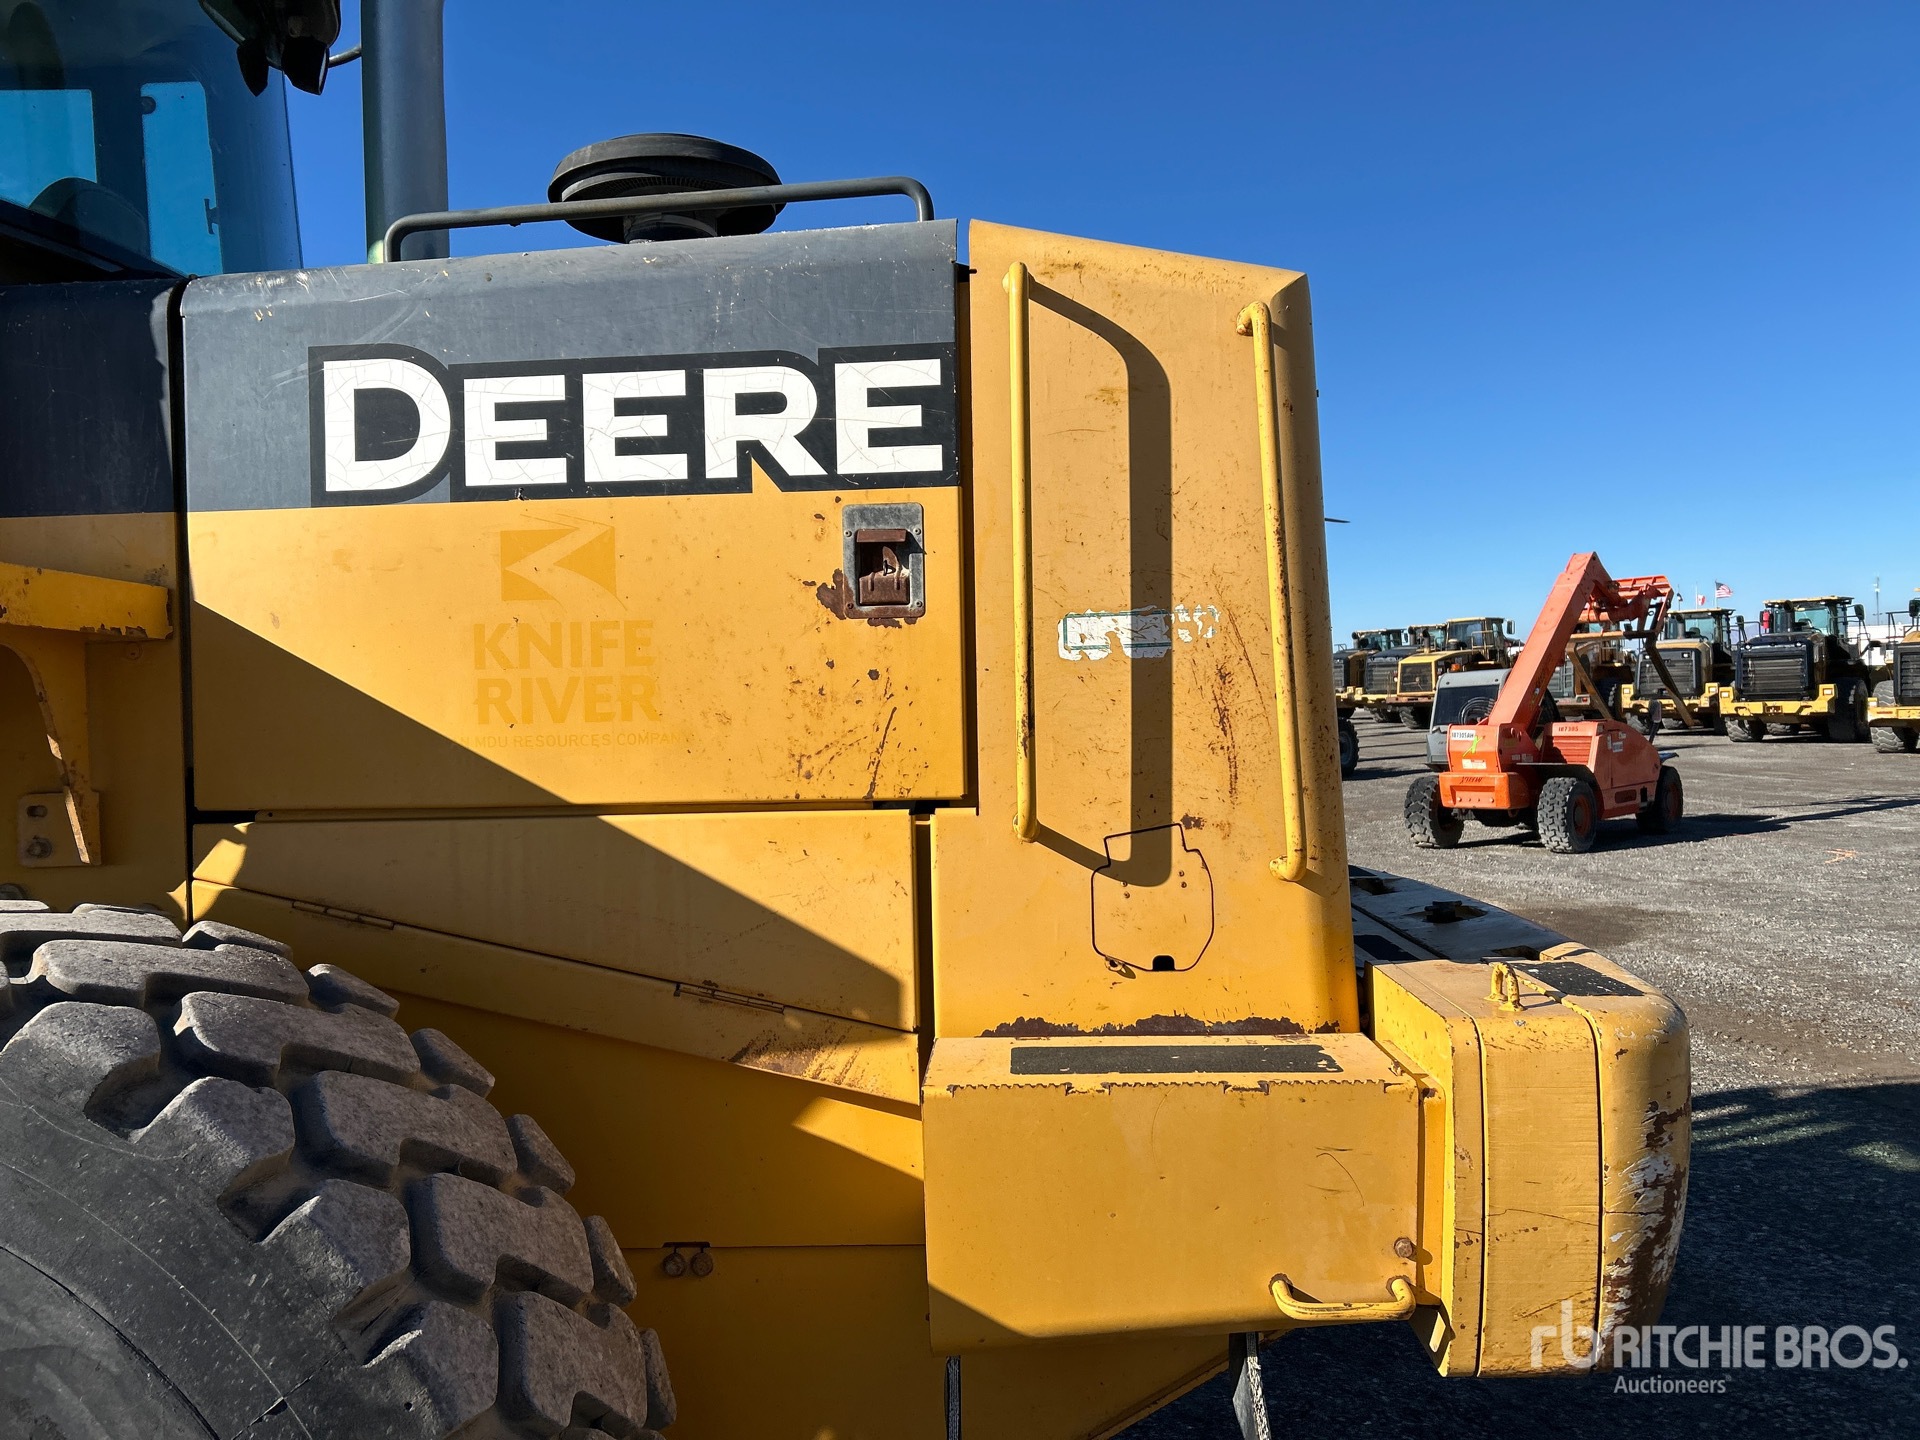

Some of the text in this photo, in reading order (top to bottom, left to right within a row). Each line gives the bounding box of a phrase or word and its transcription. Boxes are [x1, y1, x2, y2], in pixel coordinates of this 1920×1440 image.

[323, 357, 943, 492] DEERE
[473, 620, 657, 670] KNIFE
[476, 675, 662, 725] RIVER
[475, 735, 508, 749] MDU
[513, 733, 611, 749] RESOURCES
[616, 731, 692, 747] COMPAN
